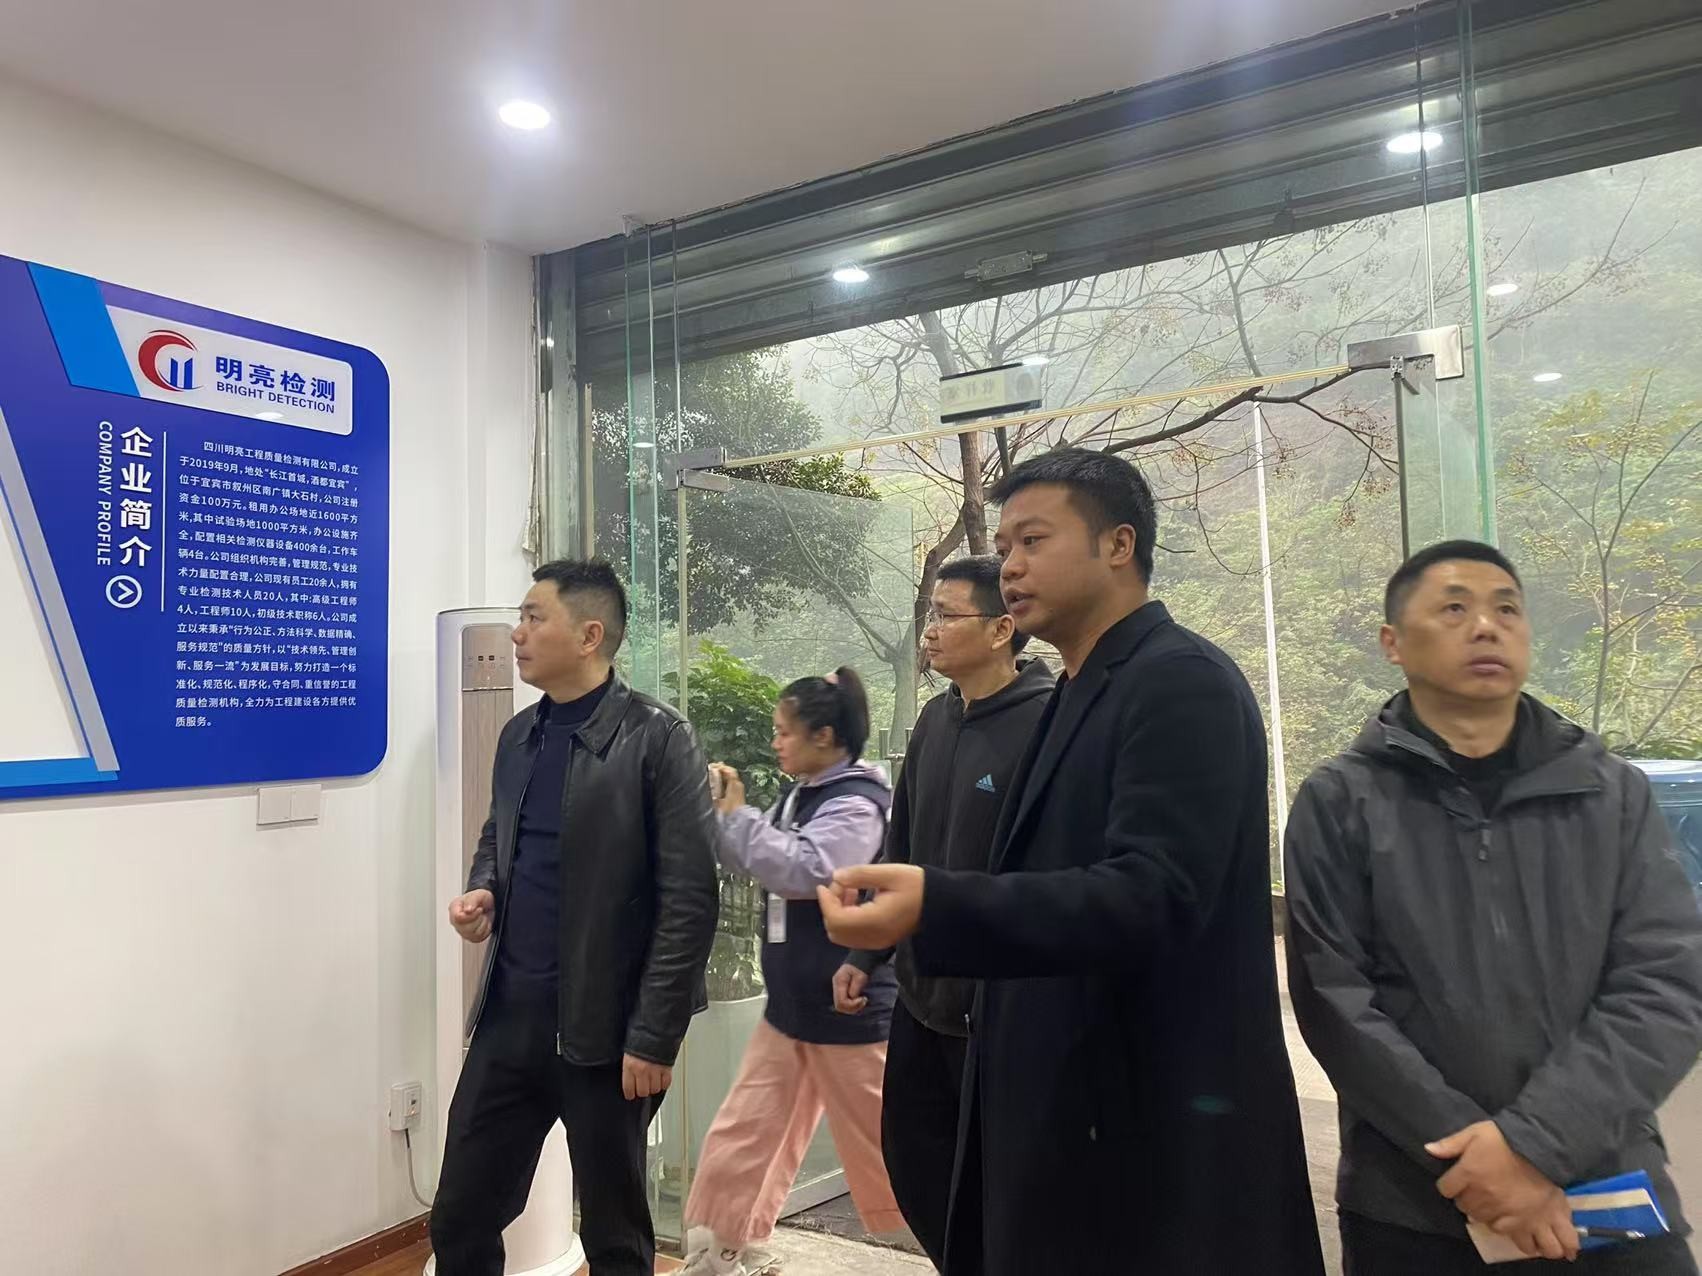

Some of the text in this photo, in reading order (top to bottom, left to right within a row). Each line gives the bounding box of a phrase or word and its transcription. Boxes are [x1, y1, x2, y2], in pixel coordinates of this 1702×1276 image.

[215, 356, 336, 402] 明亮检测
[216, 381, 335, 414] BRIGHT DETECTION
[97, 421, 113, 566] COMPANY PROFILE
[119, 426, 153, 567] 企业简介
[175, 716, 213, 728] 质服务。
